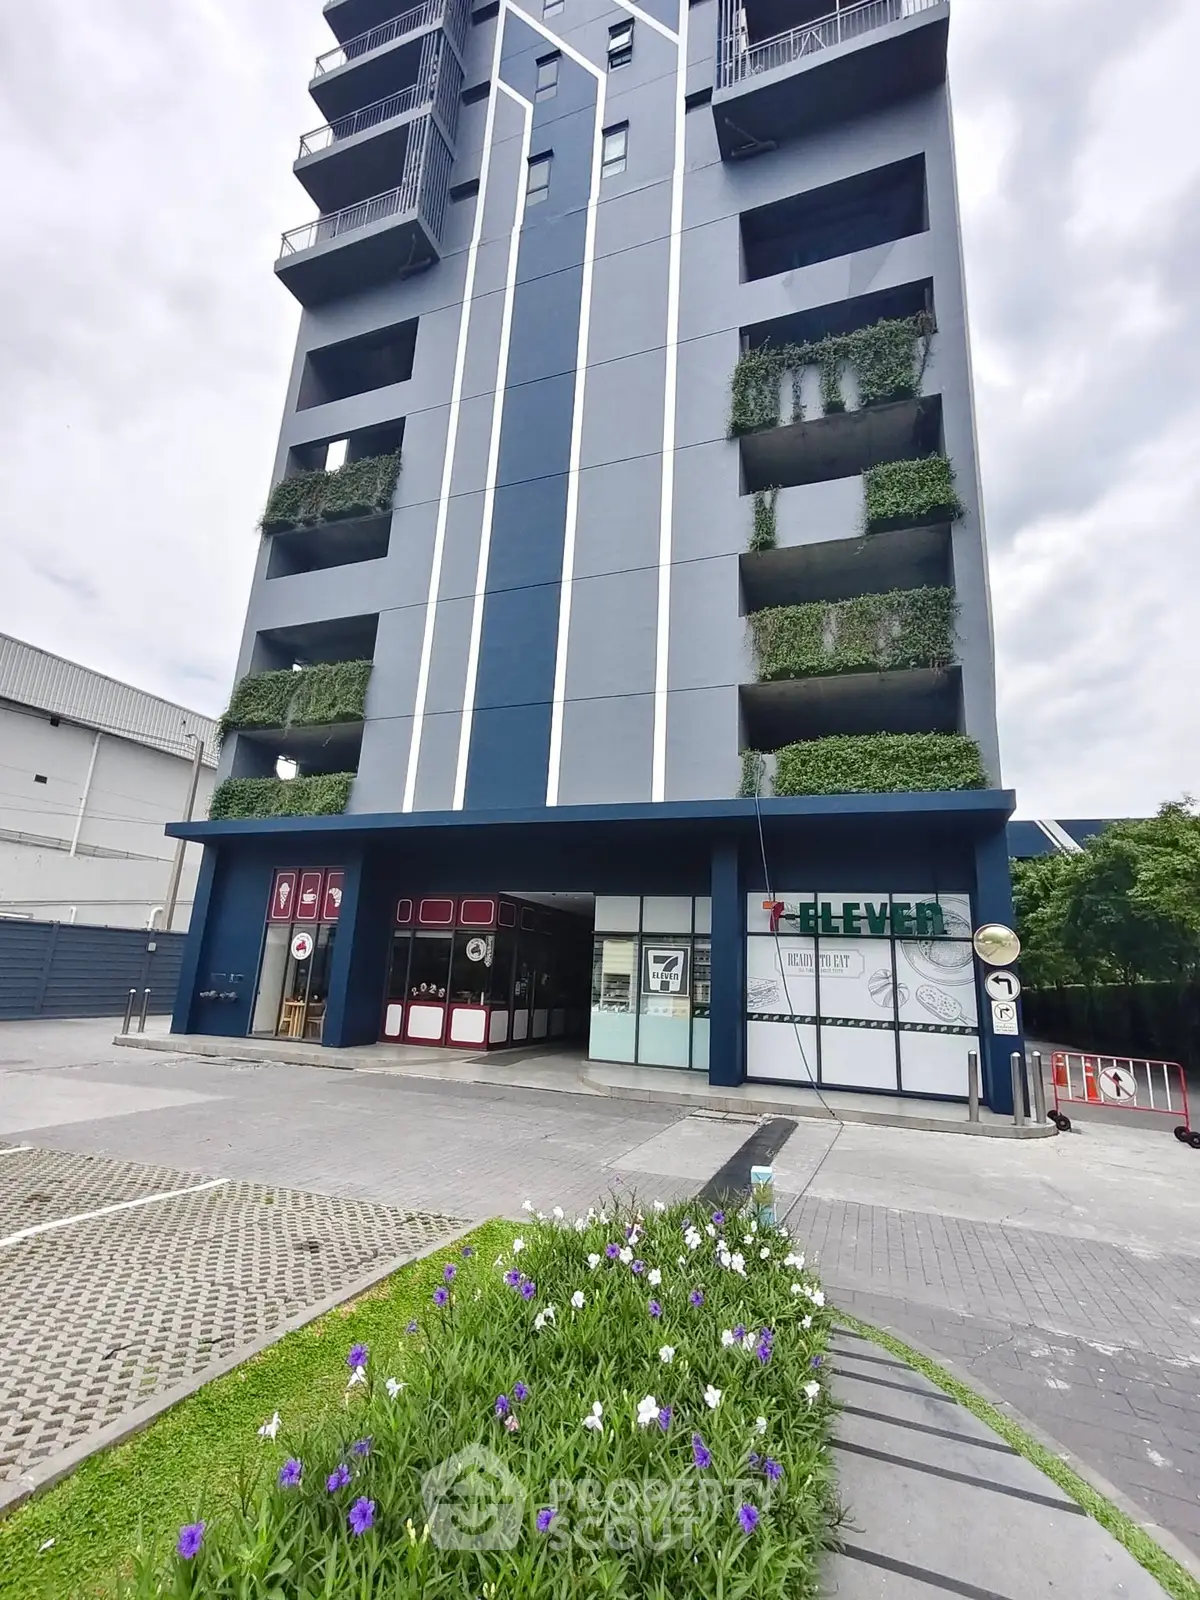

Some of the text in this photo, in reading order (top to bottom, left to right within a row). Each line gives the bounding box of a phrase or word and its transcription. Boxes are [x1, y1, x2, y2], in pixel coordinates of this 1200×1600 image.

[787, 952, 850, 969] READY TO EAT
